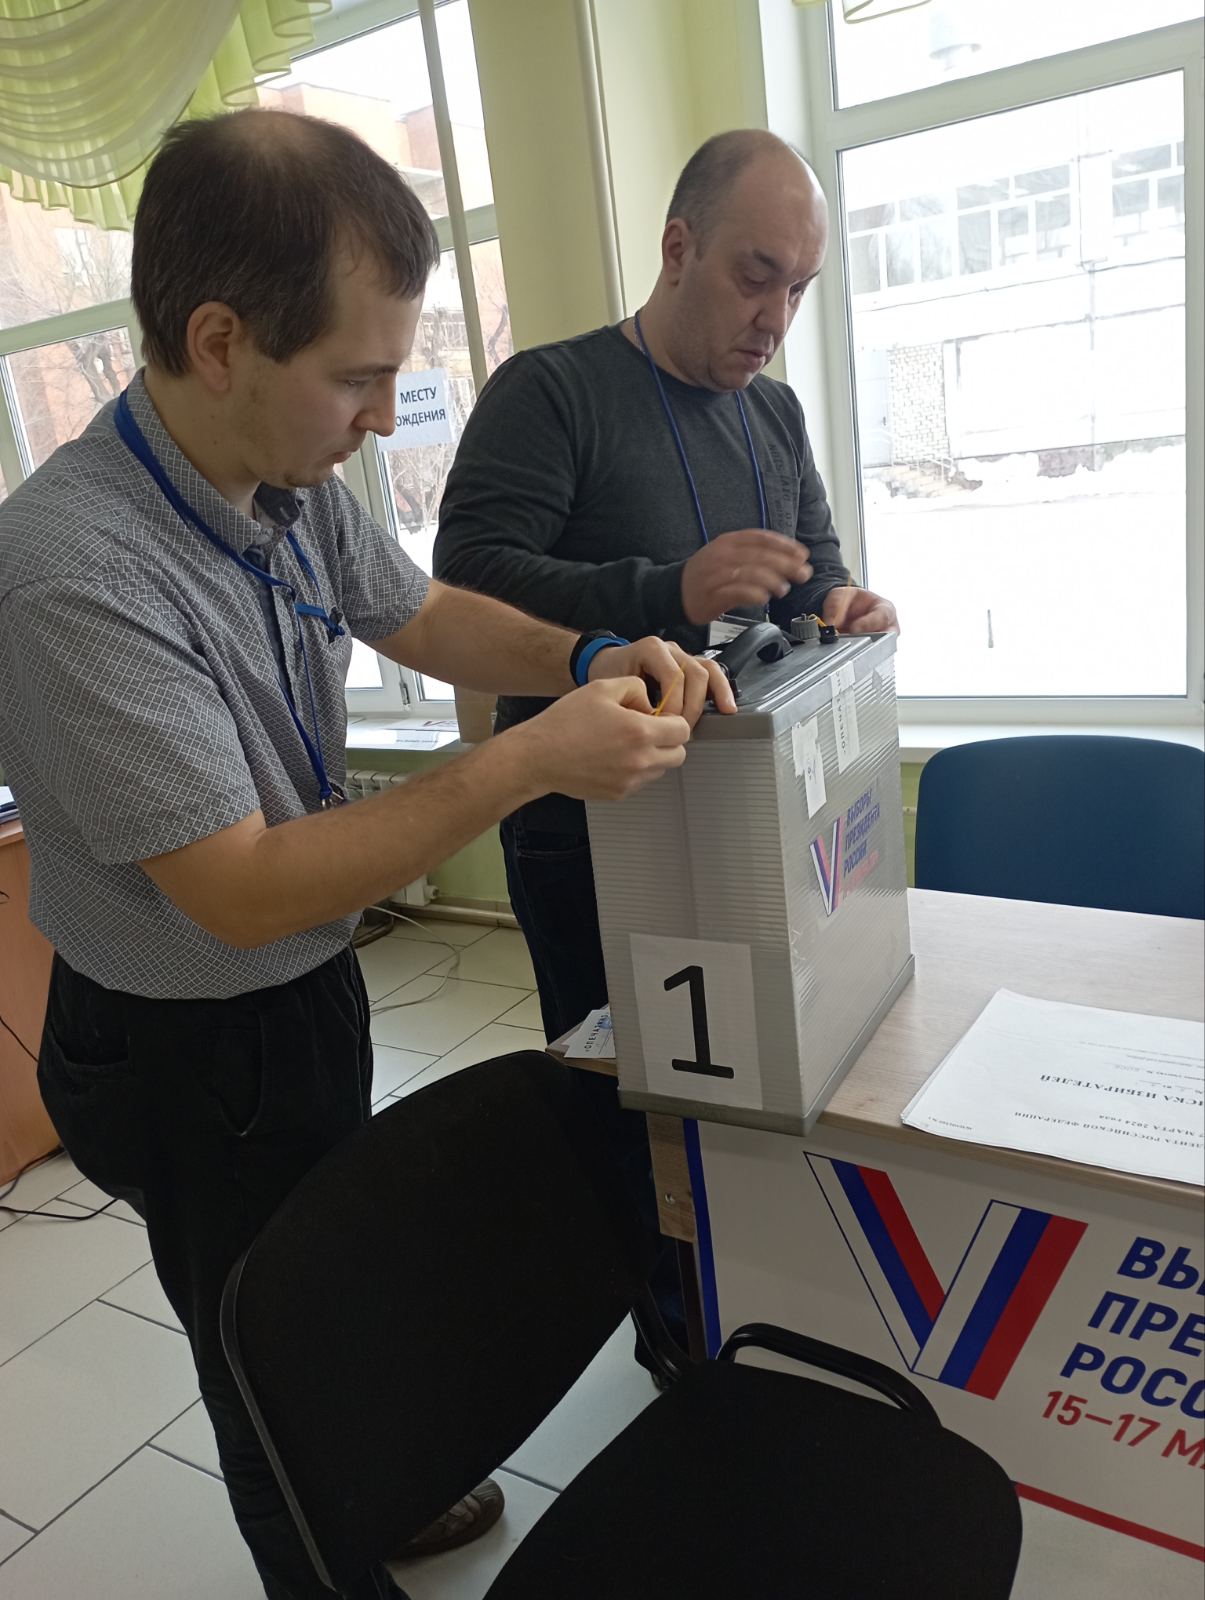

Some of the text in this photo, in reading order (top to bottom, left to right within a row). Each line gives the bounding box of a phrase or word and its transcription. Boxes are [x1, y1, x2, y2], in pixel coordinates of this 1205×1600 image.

[400, 386, 437, 404] МЕСТУ
[663, 965, 735, 1080] 1
[1040, 1074, 1157, 1099] ИЗБИРАТЕЛЕЙ
[1087, 1290, 1204, 1357] ПРЕ
